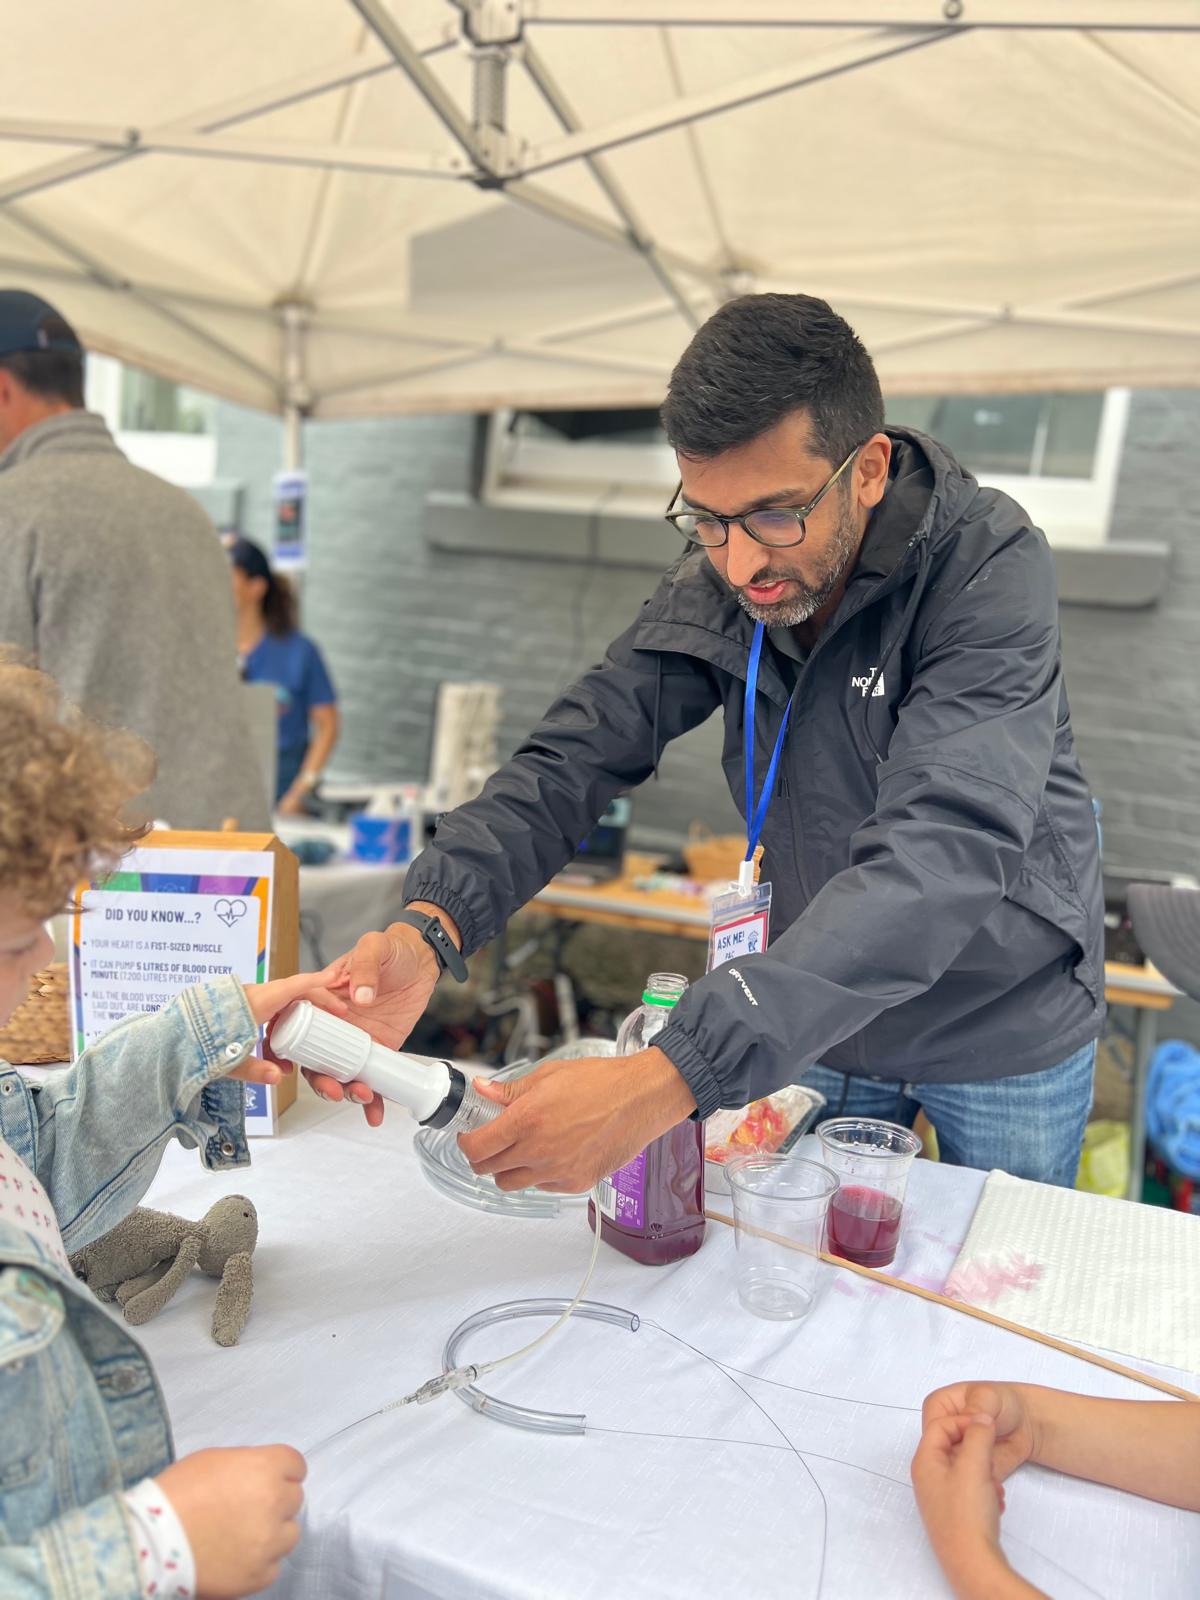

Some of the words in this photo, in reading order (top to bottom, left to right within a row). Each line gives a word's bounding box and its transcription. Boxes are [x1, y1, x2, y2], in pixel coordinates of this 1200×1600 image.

[105, 908, 124, 920] DID
[127, 909, 148, 922] YOU
[152, 910, 202, 924] KNOW...?
[91, 940, 109, 948] YOUR
[111, 940, 134, 950] HEART
[136, 940, 143, 950] IS
[144, 941, 150, 950] A
[151, 942, 191, 952] FIST-SIZED
[192, 944, 223, 953] MUSCLE
[718, 935, 732, 950] ASK
[733, 930, 745, 945] ME!
[91, 959, 97, 968] IT
[99, 960, 114, 969] CAN
[115, 960, 135, 970] PUMP
[136, 962, 141, 970] 5
[143, 962, 169, 972] LITRES
[171, 963, 180, 973] OF
[182, 964, 206, 974] BLOOD
[208, 965, 232, 975] EVERY
[91, 970, 118, 980] MINUTE
[143, 972, 168, 982] LITRES
[169, 974, 183, 983] PER
[728, 968, 758, 1006] DRYVENT
[92, 990, 105, 999] ALL
[106, 991, 120, 1000] THE
[121, 992, 144, 1001] BLOOD
[92, 1002, 108, 1010] LAID
[127, 1003, 142, 1012] ARE
[93, 1011, 106, 1020] THE
